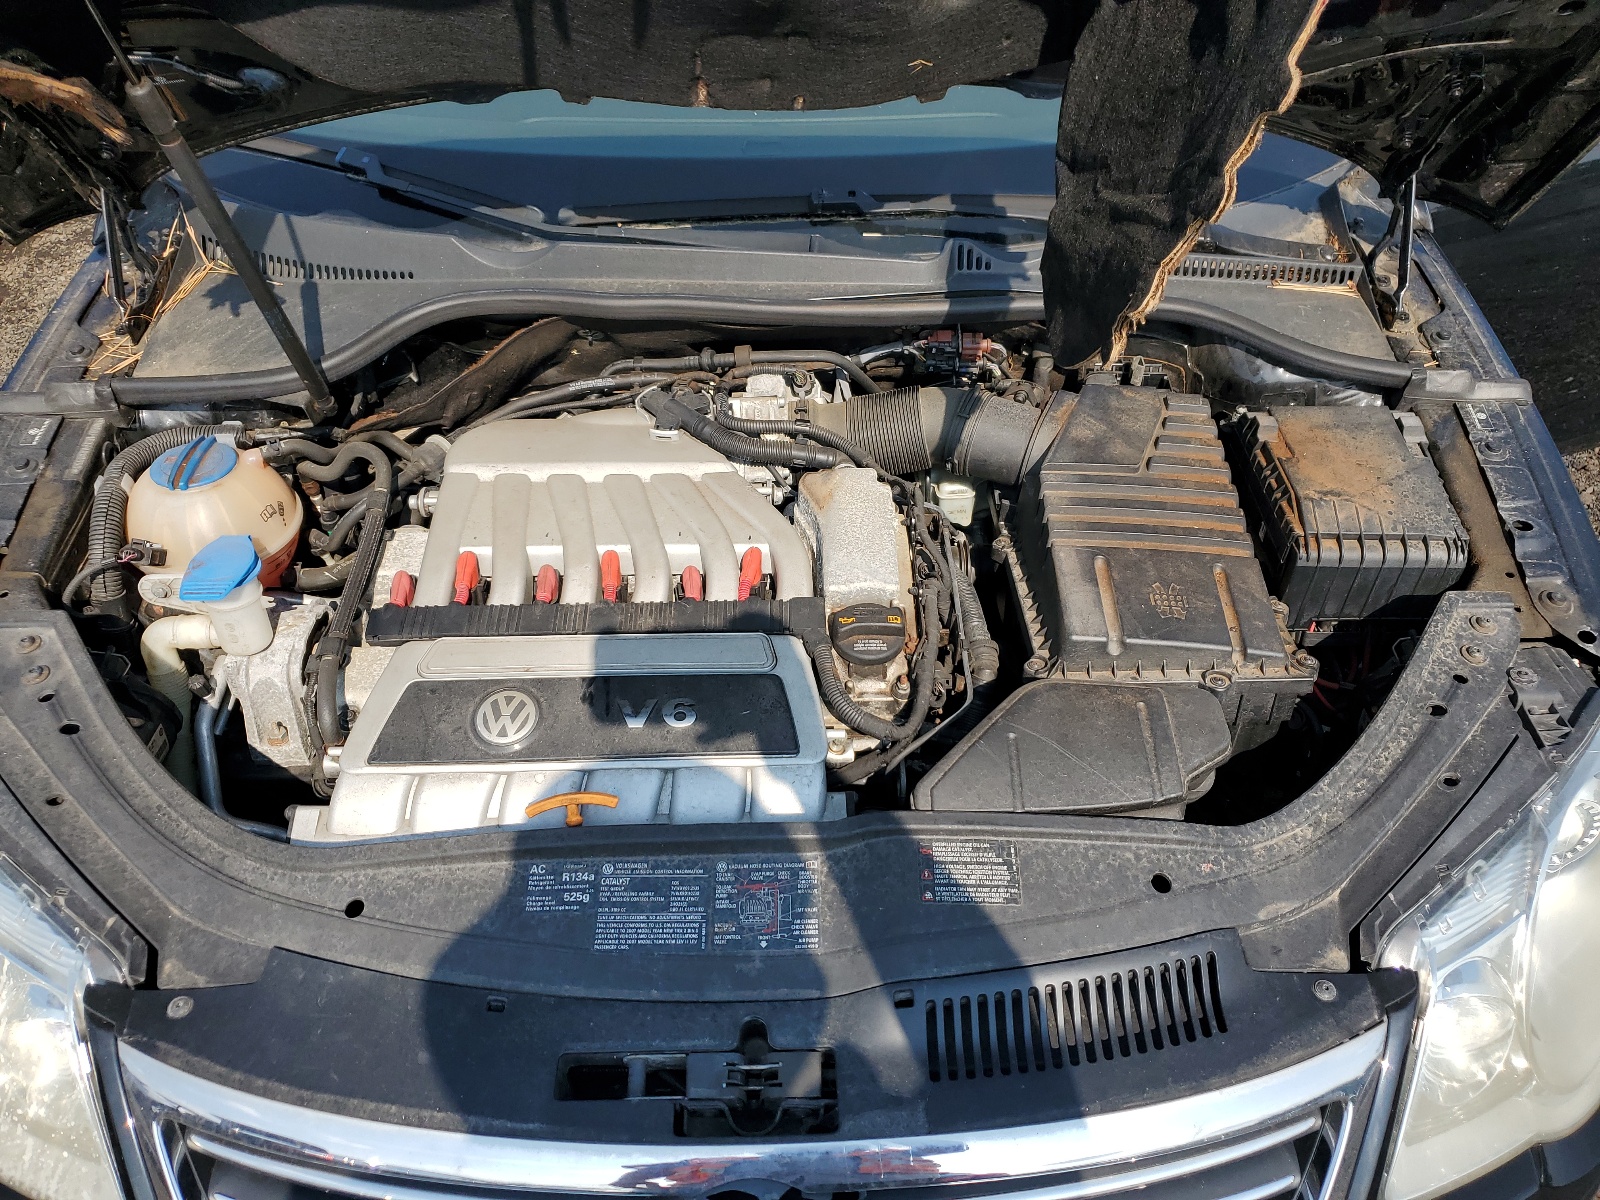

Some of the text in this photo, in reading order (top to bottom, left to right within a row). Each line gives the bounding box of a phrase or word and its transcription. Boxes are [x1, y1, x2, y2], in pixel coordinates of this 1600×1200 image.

[617, 699, 697, 728] V6
[530, 864, 546, 874] AC
[562, 872, 595, 881] R134a
[563, 892, 590, 903] 525g
